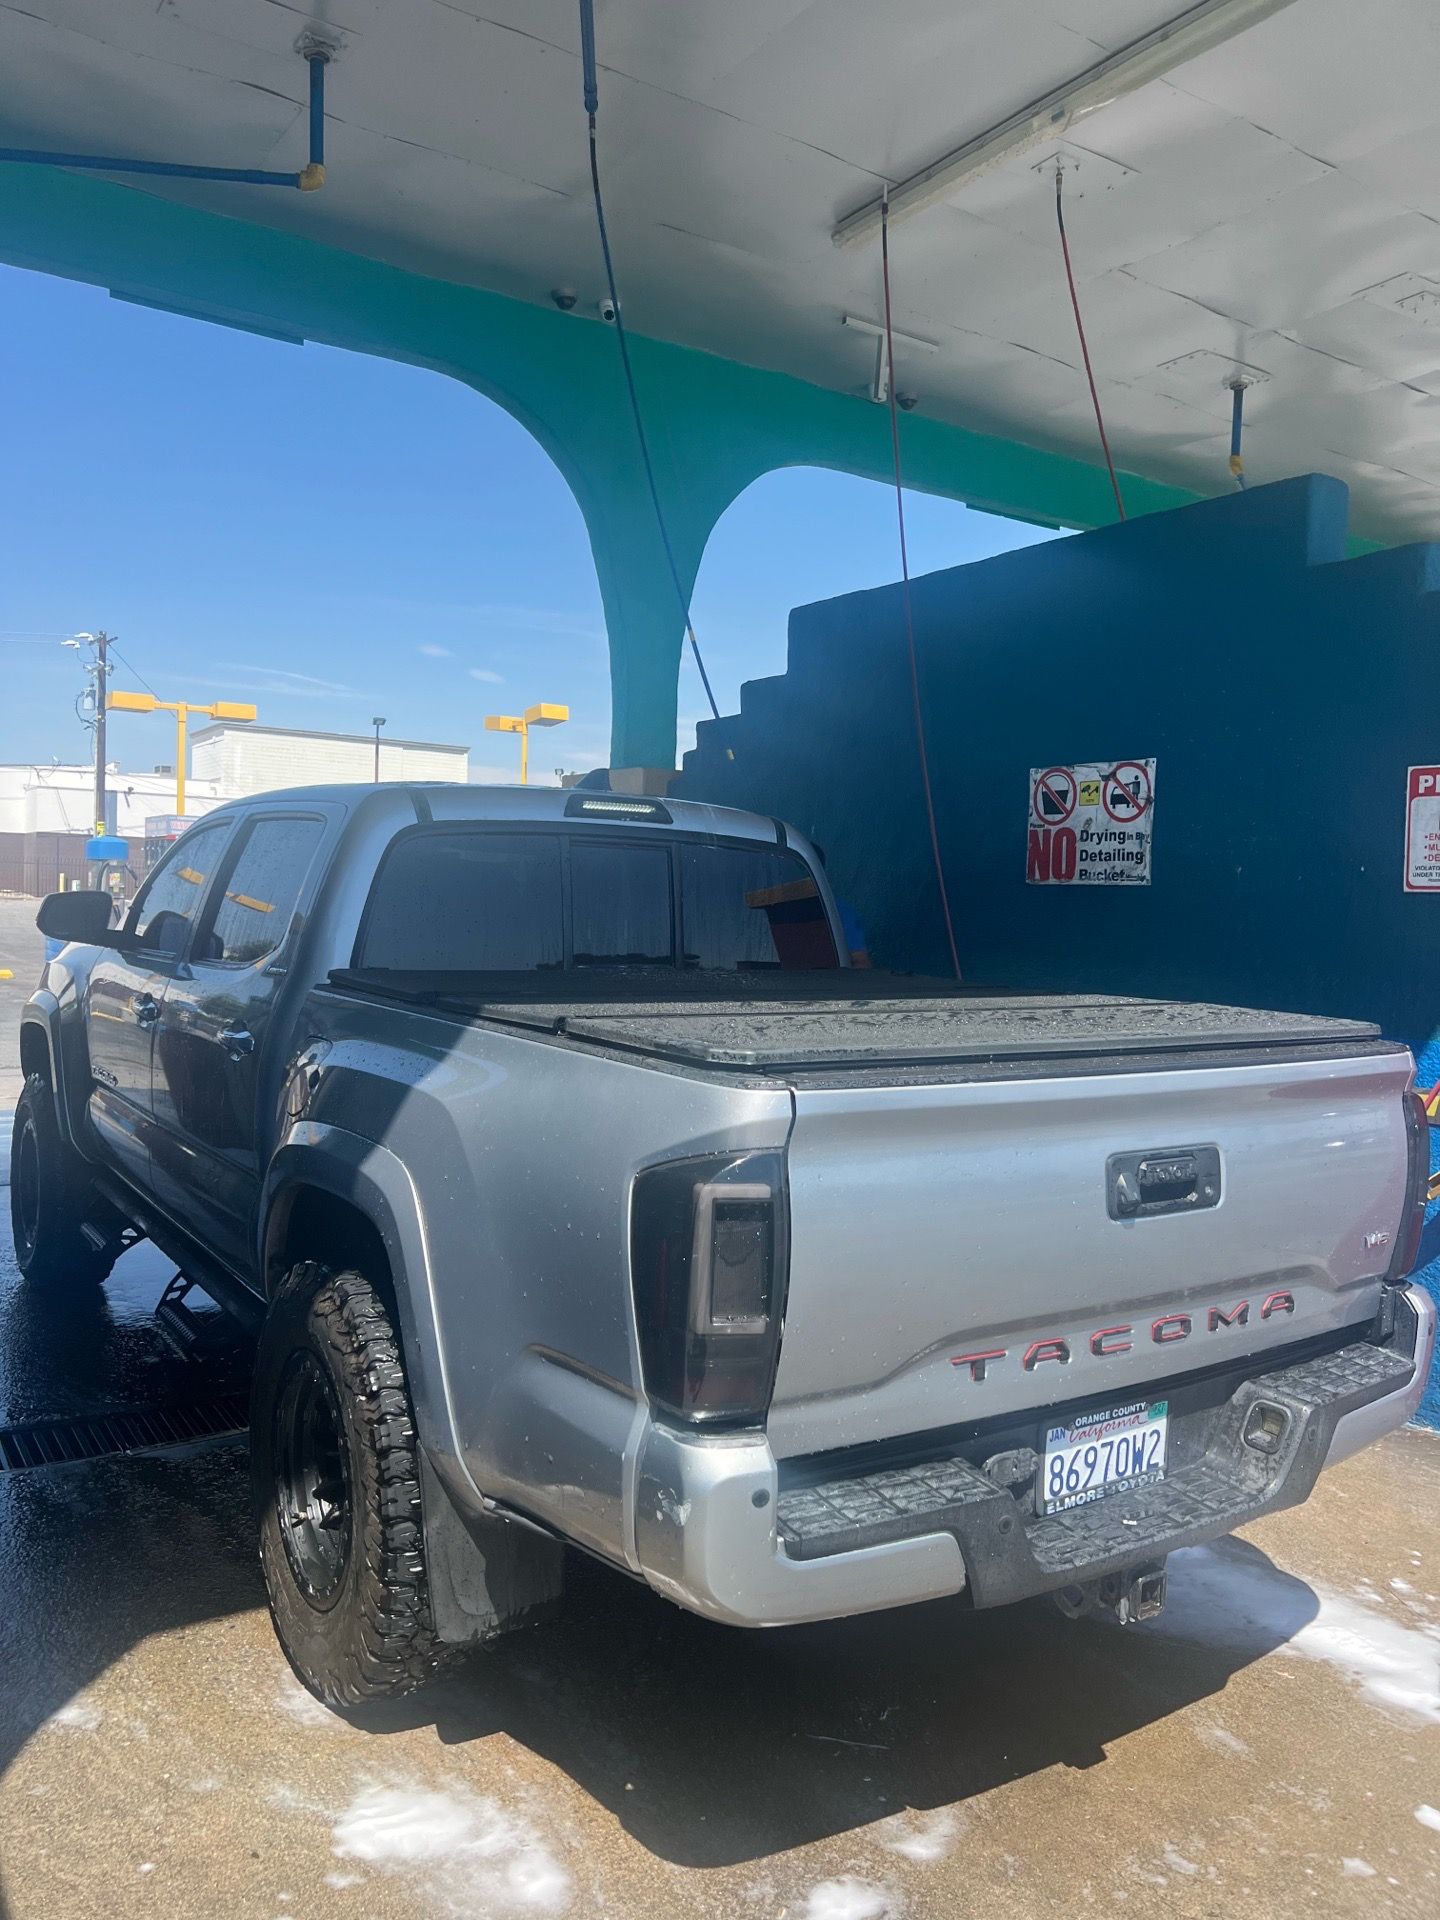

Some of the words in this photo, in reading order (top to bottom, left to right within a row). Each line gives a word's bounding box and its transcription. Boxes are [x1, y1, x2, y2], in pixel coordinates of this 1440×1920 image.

[1080, 829, 1127, 845] Drying
[1127, 832, 1134, 841] in
[1027, 827, 1077, 882] NO
[1080, 848, 1145, 864] Detailing
[950, 1290, 1295, 1382] TACOMA
[1075, 1410, 1111, 1427] ORANGE
[1112, 1402, 1147, 1417] COUNTY
[1049, 1428, 1066, 1443] JAN
[1069, 1414, 1147, 1443] California
[1049, 1429, 1161, 1497] 86970W2
[1046, 1487, 1105, 1514] ELMORE
